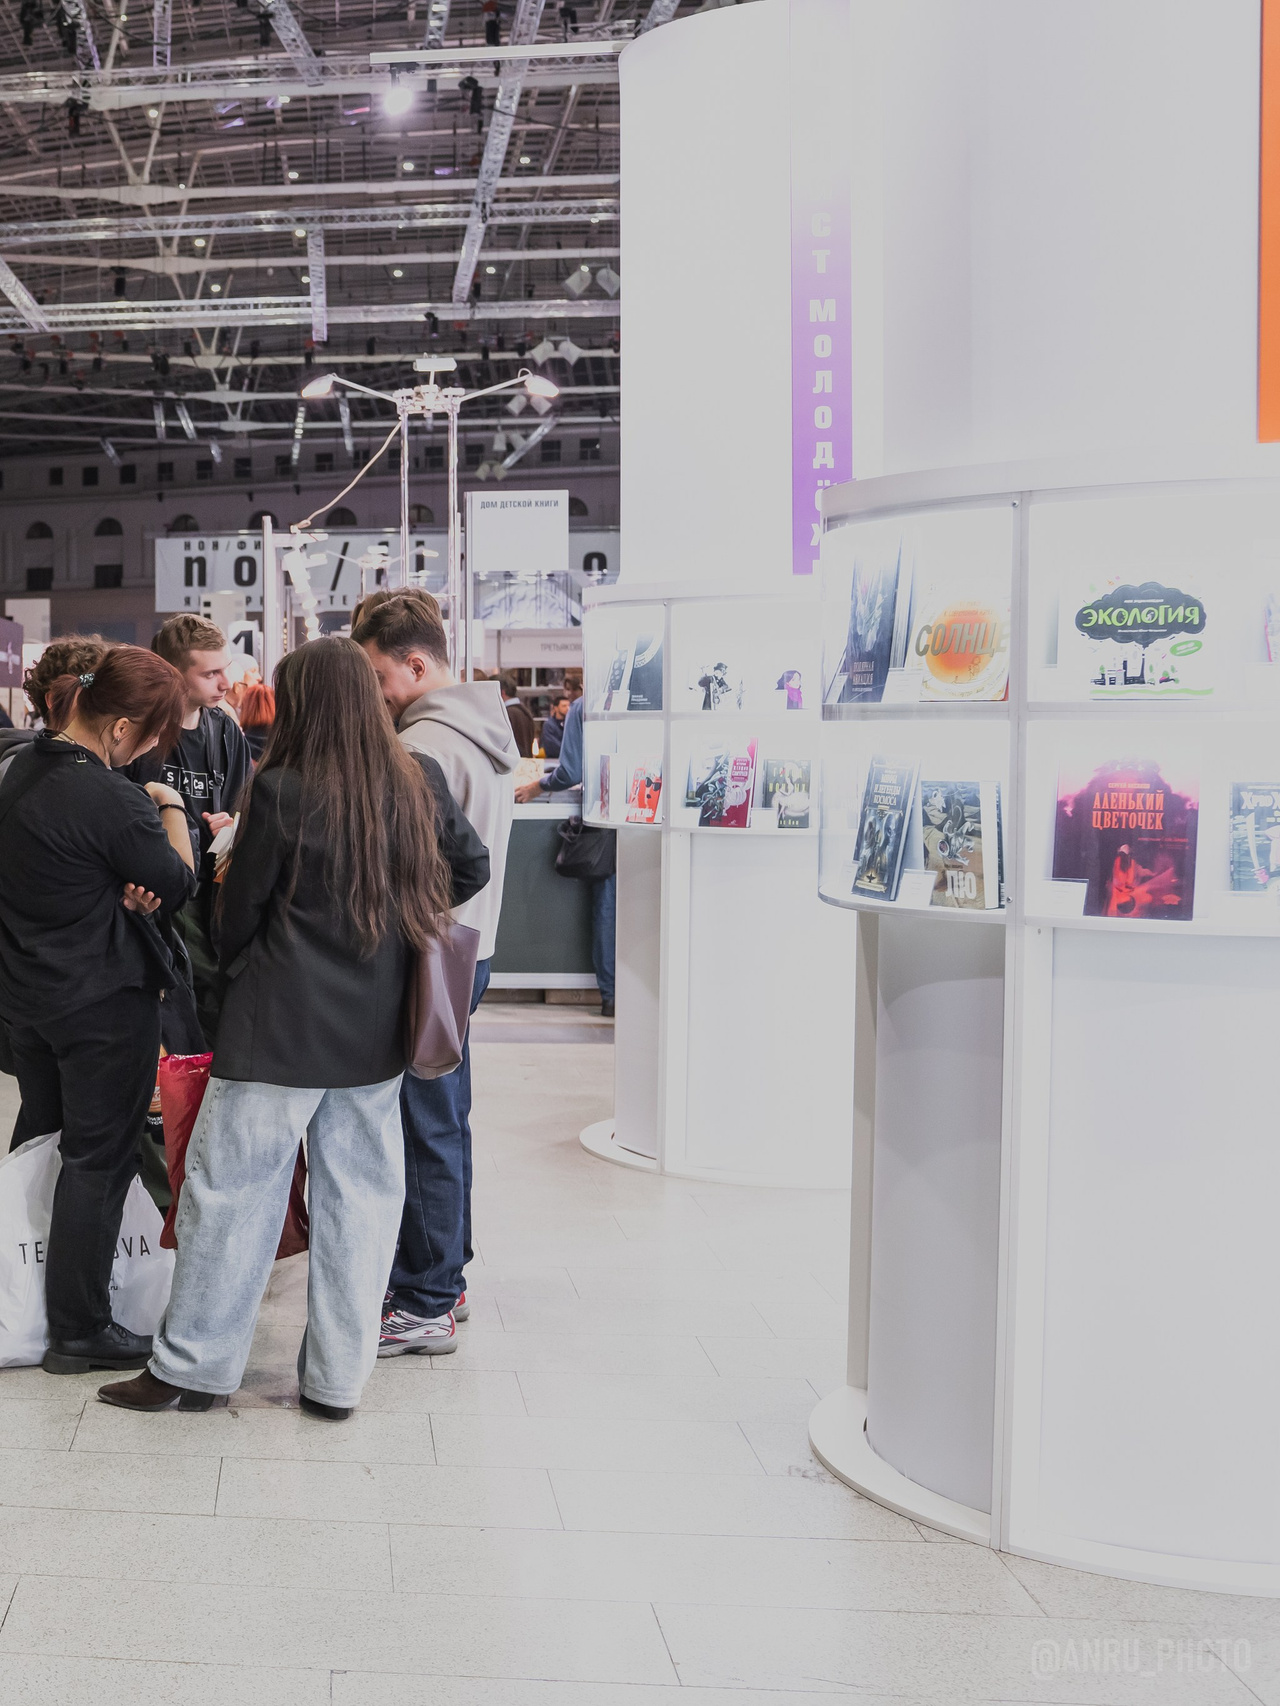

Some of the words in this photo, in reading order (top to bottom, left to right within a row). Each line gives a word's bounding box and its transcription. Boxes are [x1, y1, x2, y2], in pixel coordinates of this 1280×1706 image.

[809, 298, 836, 575] МОЛОД
[480, 500, 498, 509] ДОМ
[500, 499, 533, 509] ДЕТСКОЙ
[535, 499, 559, 508] КНИГИ
[1082, 604, 1200, 627] ЭКОЛОГИЯ
[540, 643, 583, 651] ТРЕТЬЯКОВ
[1093, 789, 1165, 810] АЛЕНЬКИЙ
[1092, 811, 1164, 830] ЦВЕТОЧЕК
